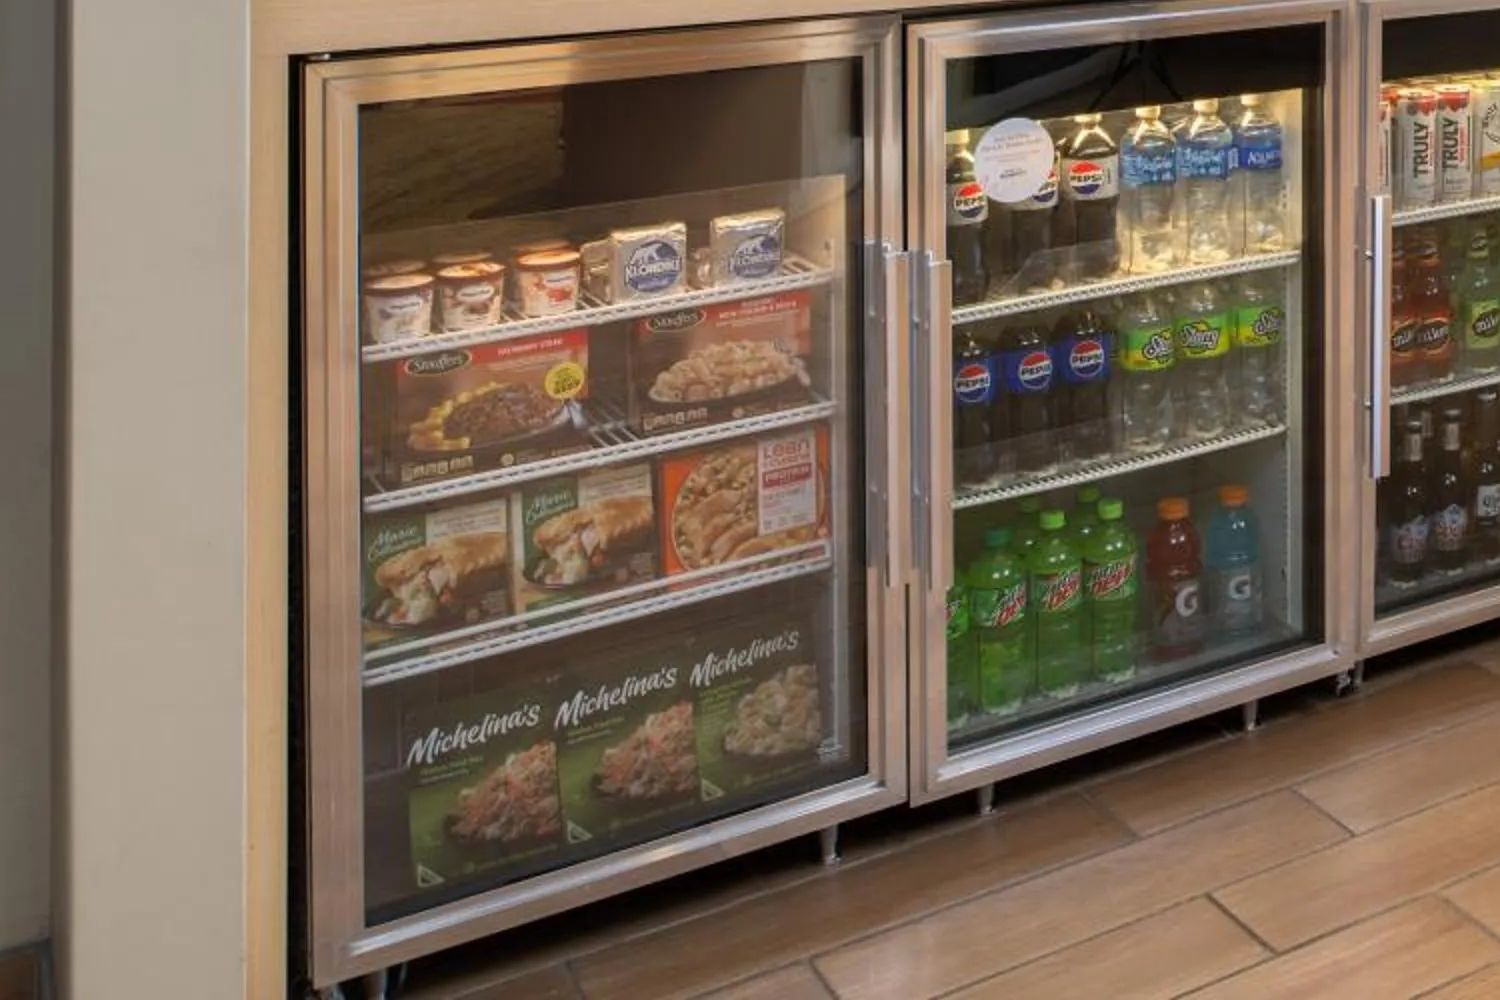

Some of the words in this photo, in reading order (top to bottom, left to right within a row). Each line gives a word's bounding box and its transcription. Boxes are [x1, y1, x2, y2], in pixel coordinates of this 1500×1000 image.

[1412, 121, 1429, 178] TRULY
[1441, 117, 1459, 170] TRULY
[1174, 583, 1199, 618] G
[1229, 574, 1251, 599] G
[689, 630, 800, 688] Michelina's
[553, 666, 678, 732] Michelina's
[406, 703, 542, 769] Michelina's
